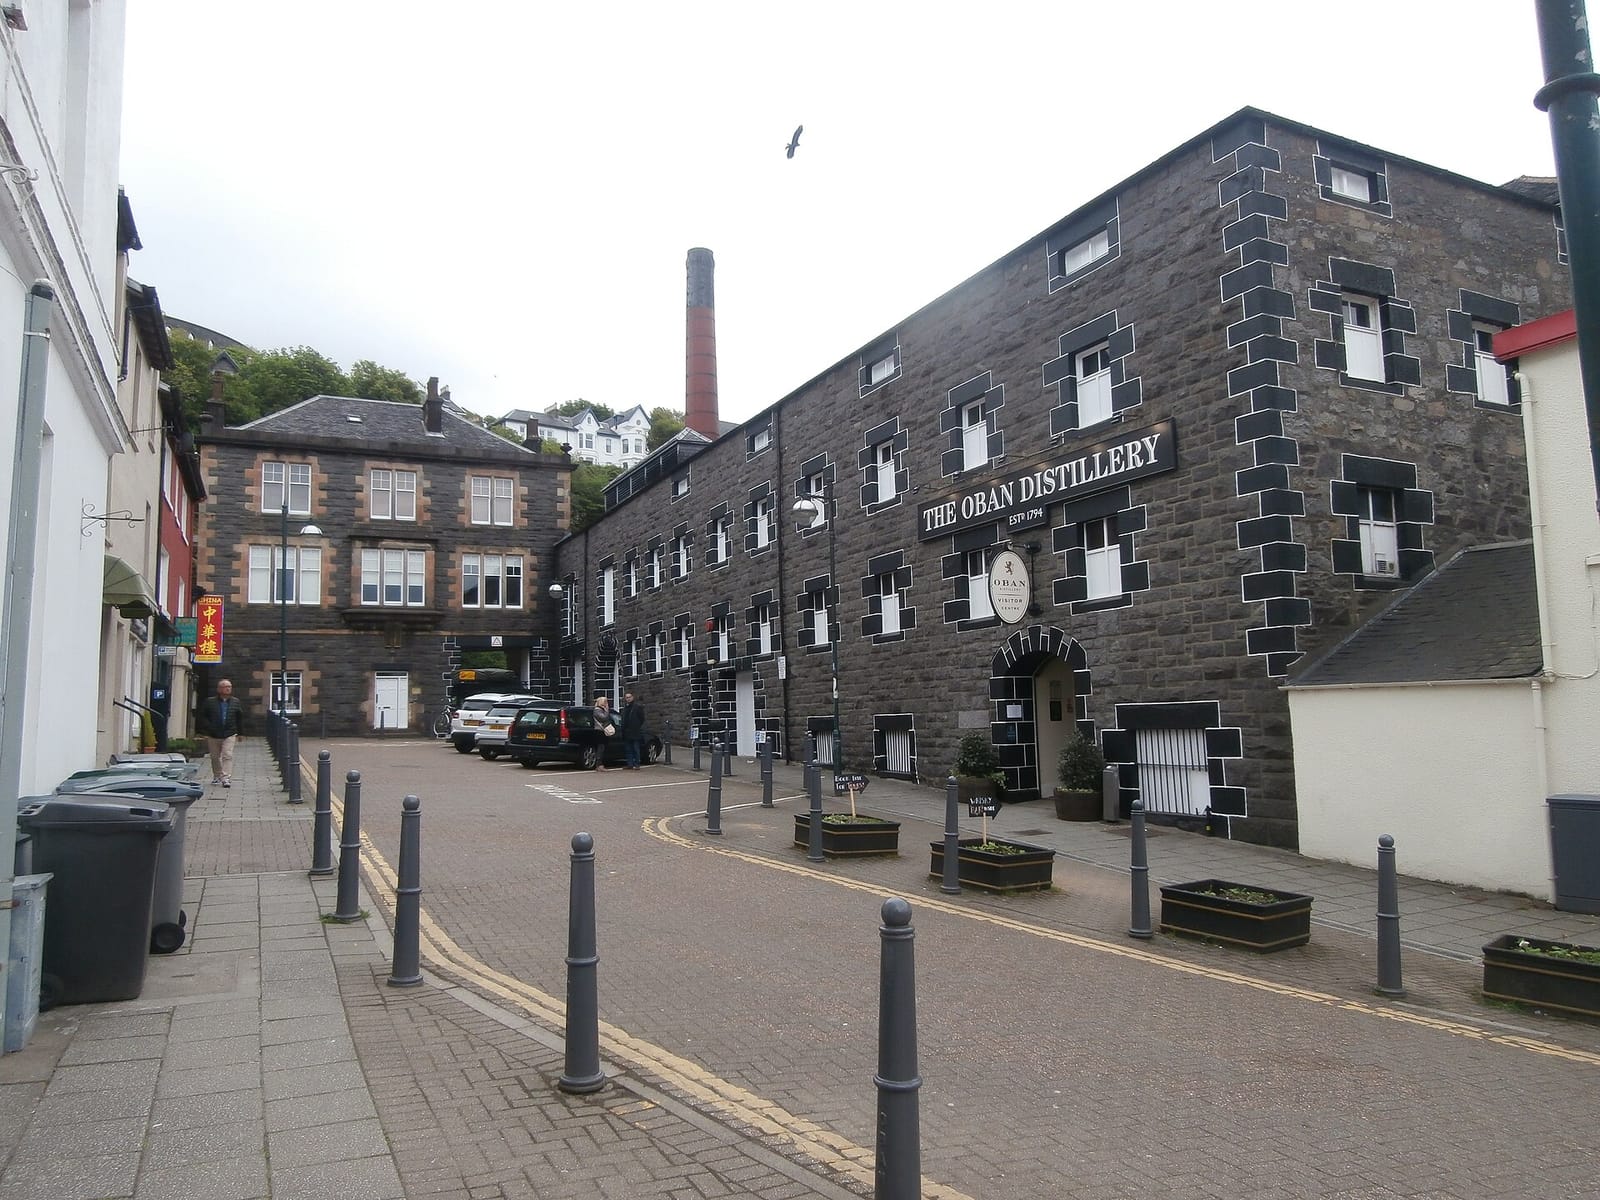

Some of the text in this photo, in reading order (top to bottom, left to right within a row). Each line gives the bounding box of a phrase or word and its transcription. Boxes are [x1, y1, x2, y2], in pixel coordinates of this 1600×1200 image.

[922, 433, 1161, 532] THE OBAN DISTILLERY
[1026, 507, 1043, 521] 1794
[993, 579, 1026, 588] OBAN
